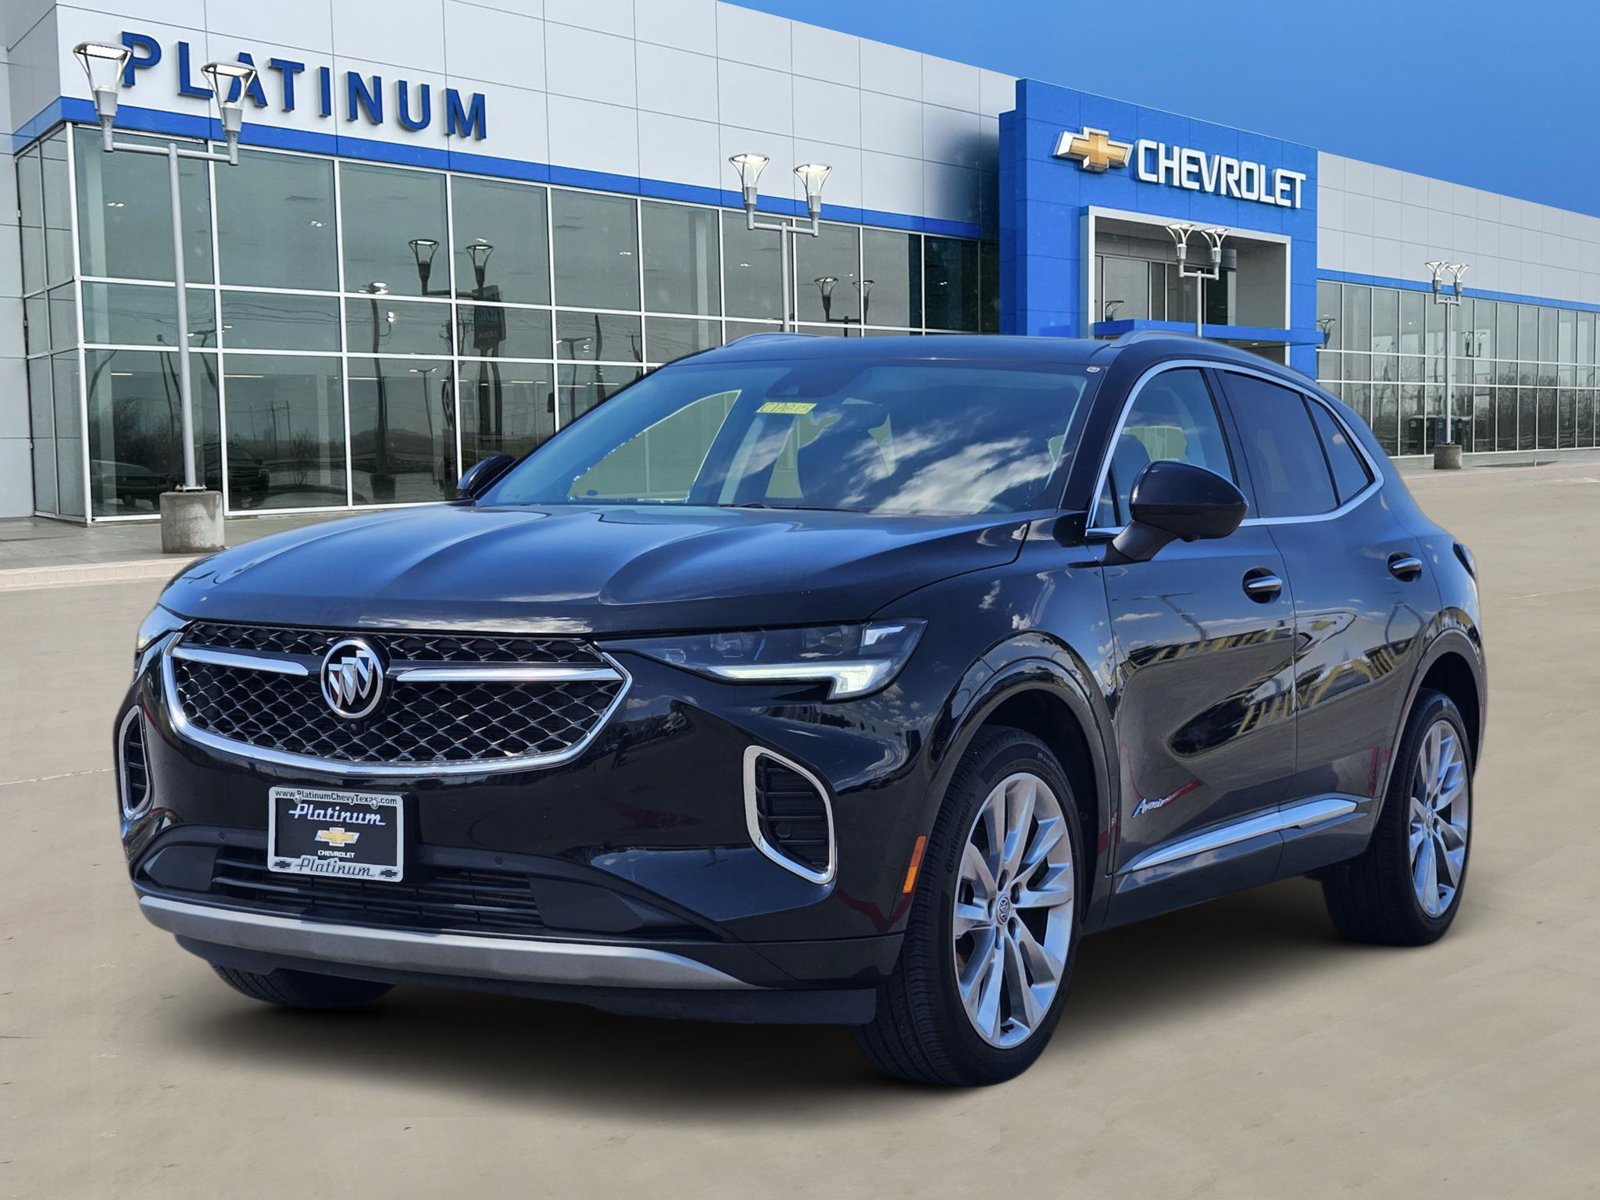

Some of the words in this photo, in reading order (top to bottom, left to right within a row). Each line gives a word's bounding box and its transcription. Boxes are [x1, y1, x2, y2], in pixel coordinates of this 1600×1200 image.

[121, 31, 487, 140] PLATINUM
[1136, 138, 1307, 209] CHEVROLET
[288, 803, 387, 826] Platinum
[317, 849, 356, 859] CHEVROLET
[295, 857, 376, 877] Platinum
